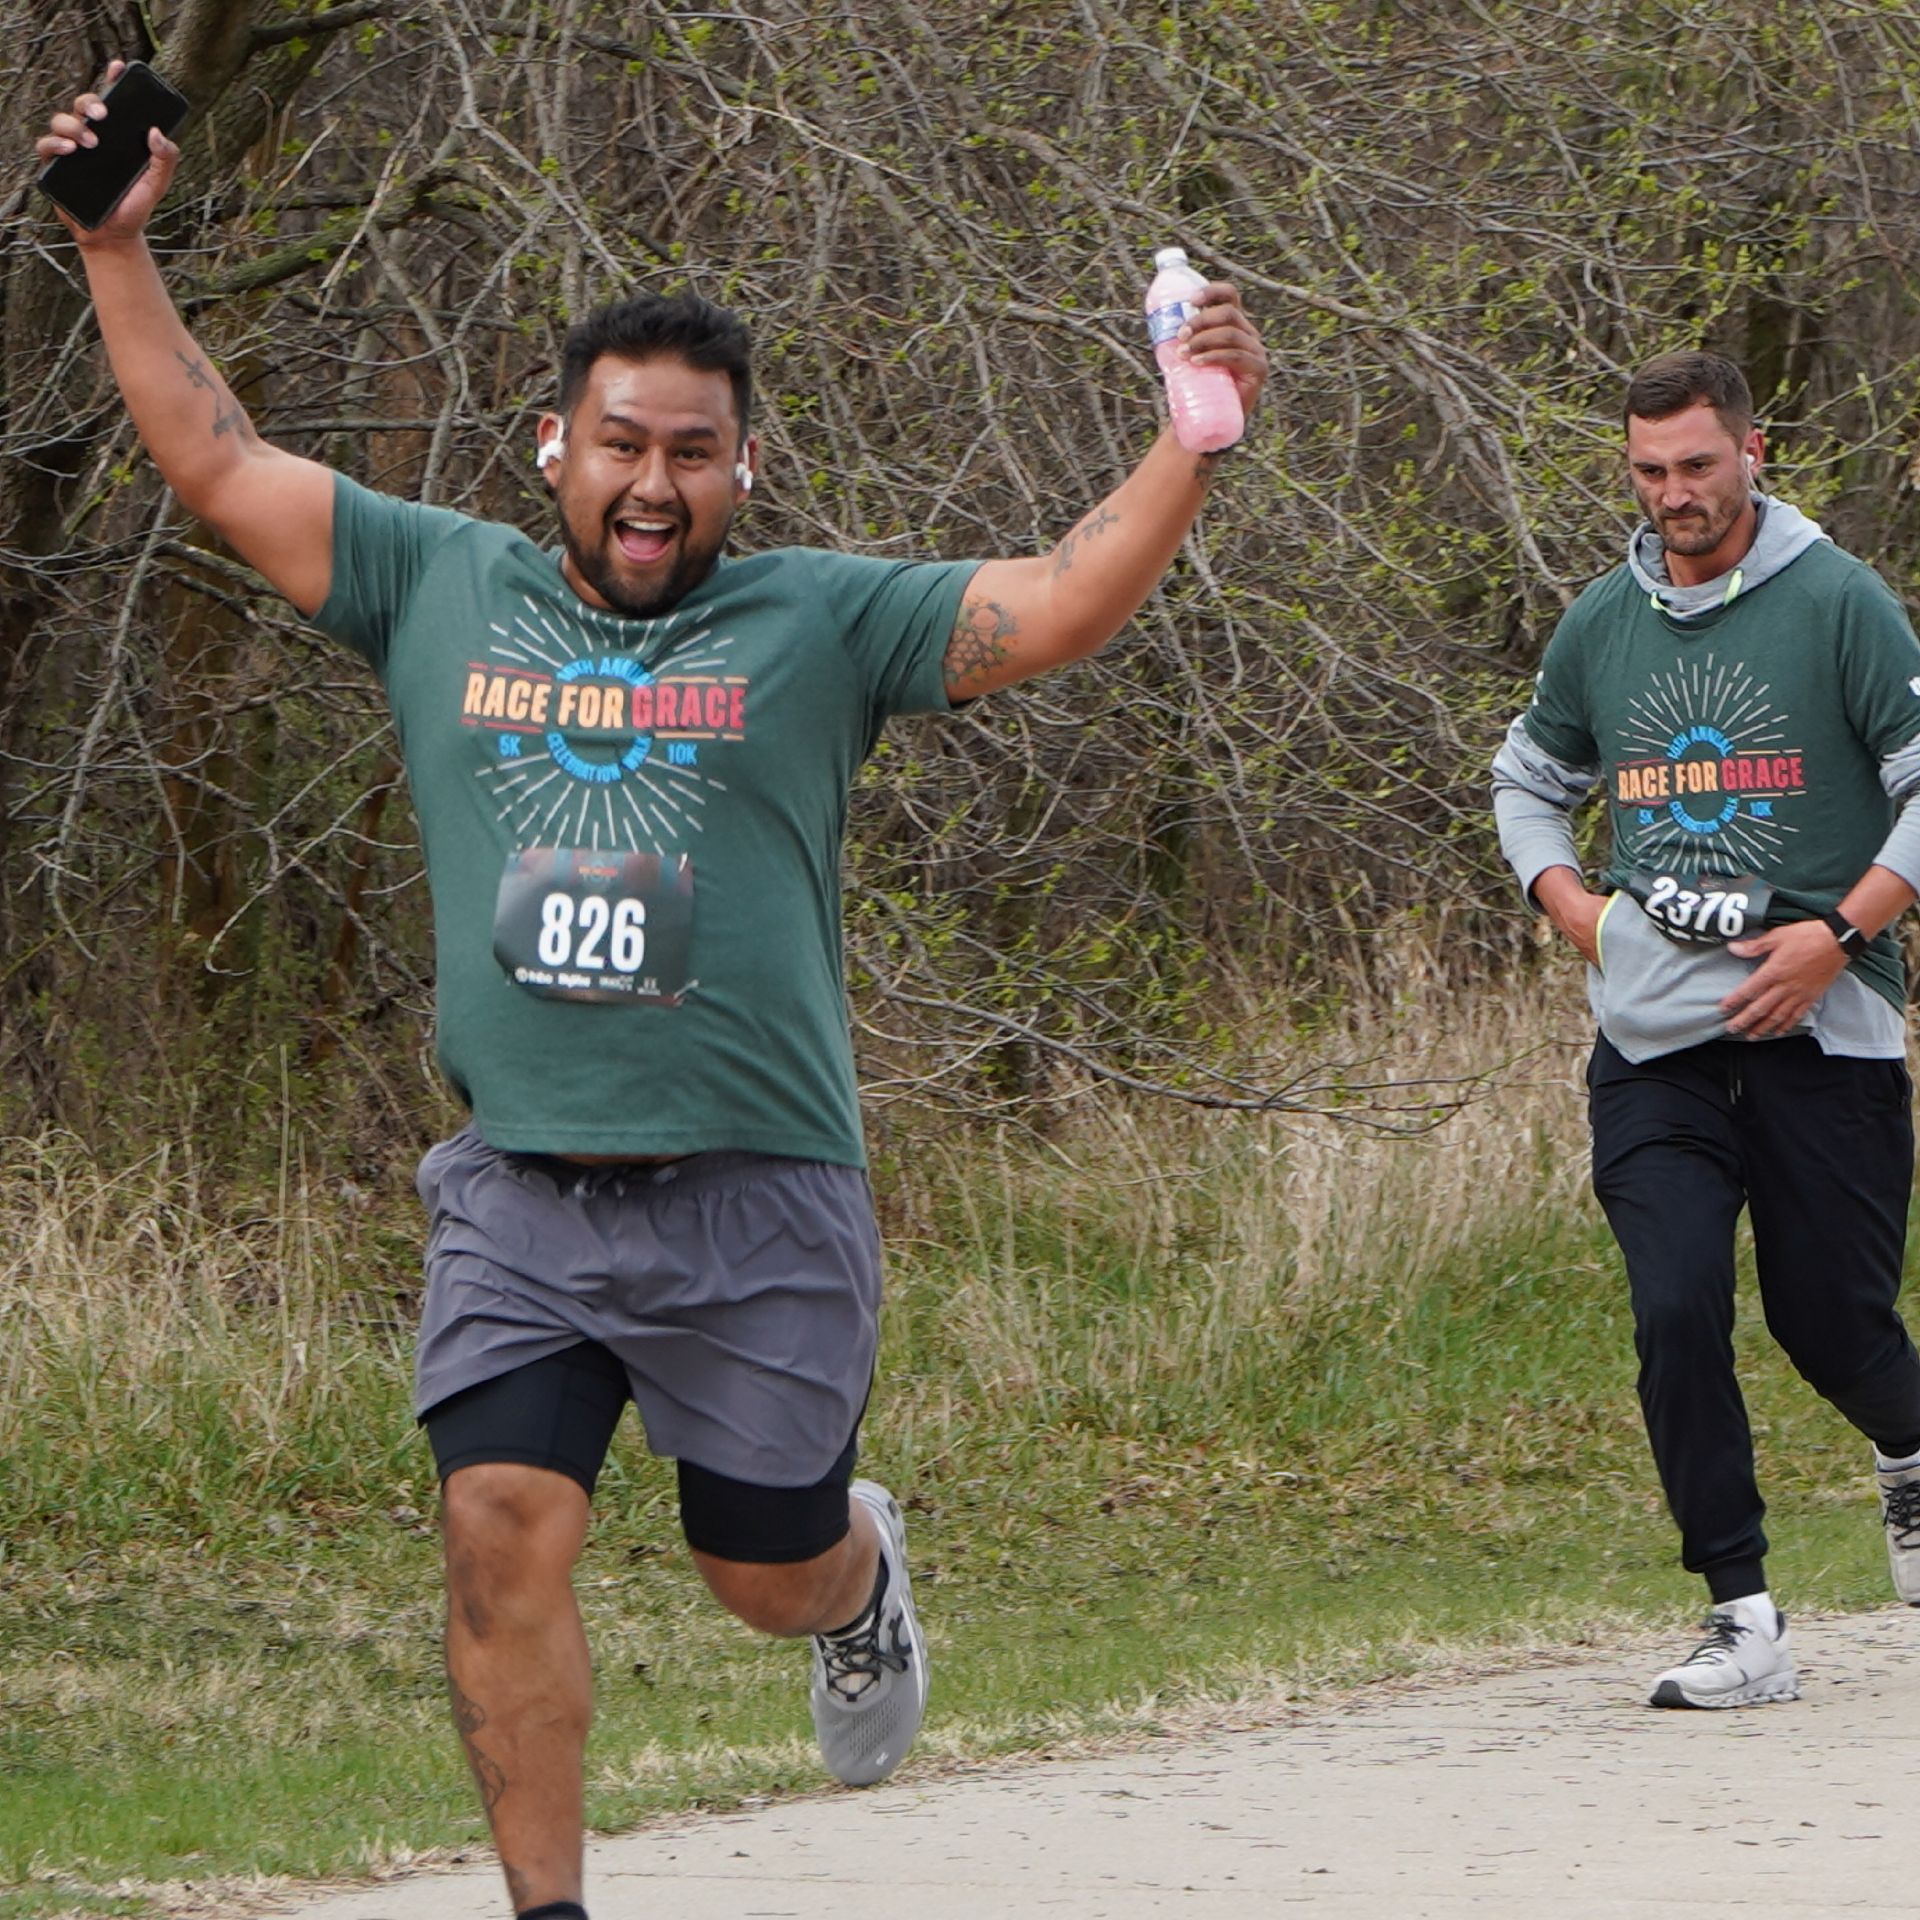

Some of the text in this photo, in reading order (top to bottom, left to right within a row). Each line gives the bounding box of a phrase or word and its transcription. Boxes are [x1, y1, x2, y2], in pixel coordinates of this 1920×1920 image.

[597, 655, 656, 687] ANNUAL
[463, 672, 746, 729] RACE FOR GRACE
[497, 732, 523, 758] 5K
[545, 731, 623, 785] CELEBRATION
[666, 741, 699, 766] 10K
[1689, 726, 1736, 758] ANNUAL
[1617, 757, 1805, 801] RACE FOR GRACE
[1644, 876, 1749, 938] 2376
[537, 892, 647, 974] 826
